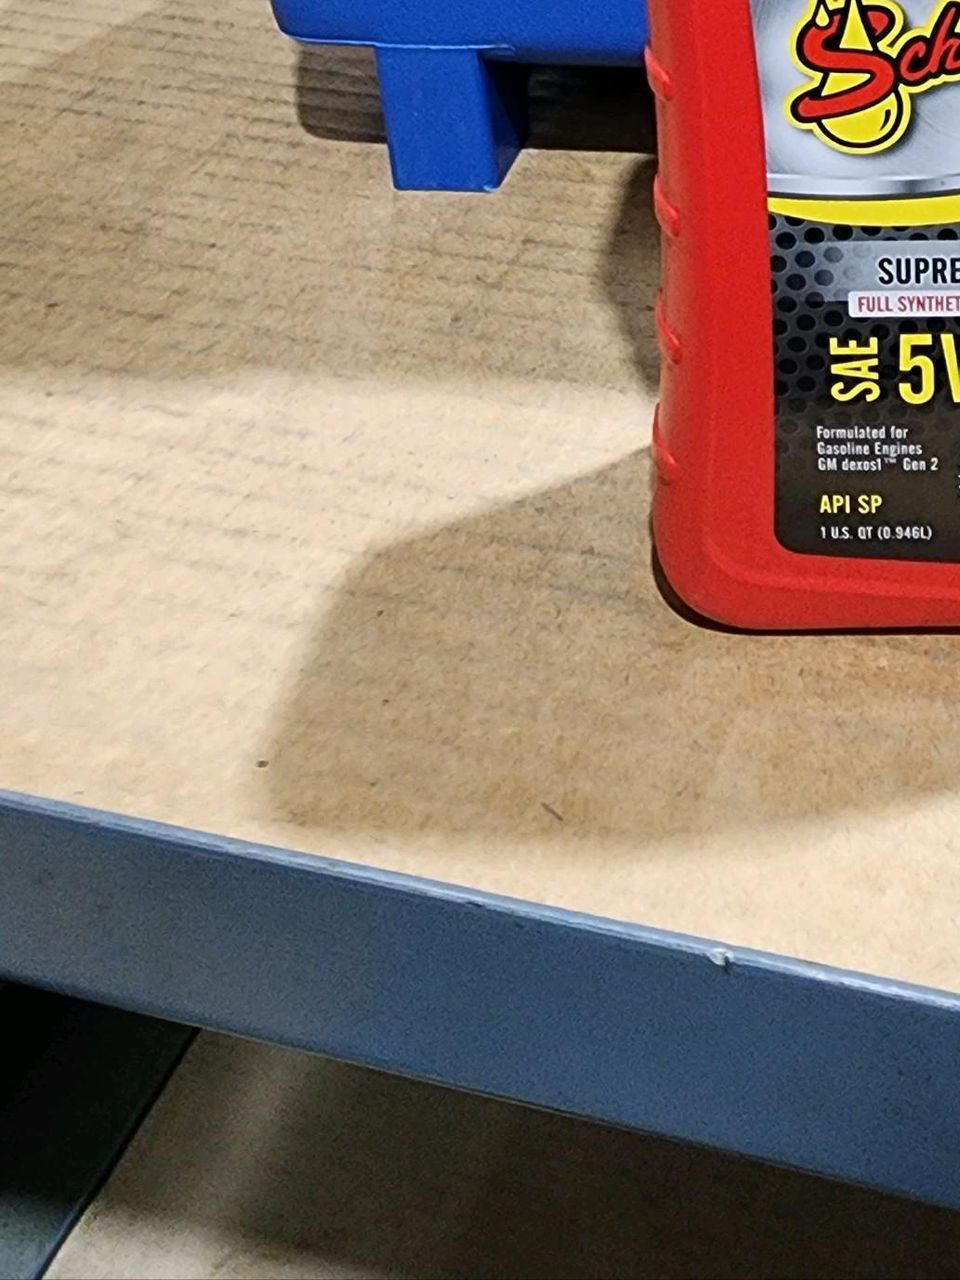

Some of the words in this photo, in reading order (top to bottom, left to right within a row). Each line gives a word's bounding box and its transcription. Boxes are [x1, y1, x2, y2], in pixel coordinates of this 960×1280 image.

[857, 296, 894, 312] FULL
[829, 336, 881, 403] SAE
[816, 425, 886, 439] Formulated
[890, 425, 909, 439] for
[817, 442, 870, 455] Gasoline
[874, 442, 923, 458] Engines
[818, 458, 838, 471] GM
[903, 457, 926, 471] Gen
[930, 457, 939, 471] 2
[819, 494, 851, 514] API
[857, 494, 882, 515] SP
[820, 526, 826, 539] 1
[830, 526, 853, 539] U.S.
[857, 526, 873, 539] QT
[877, 525, 933, 540] (0.946L)
